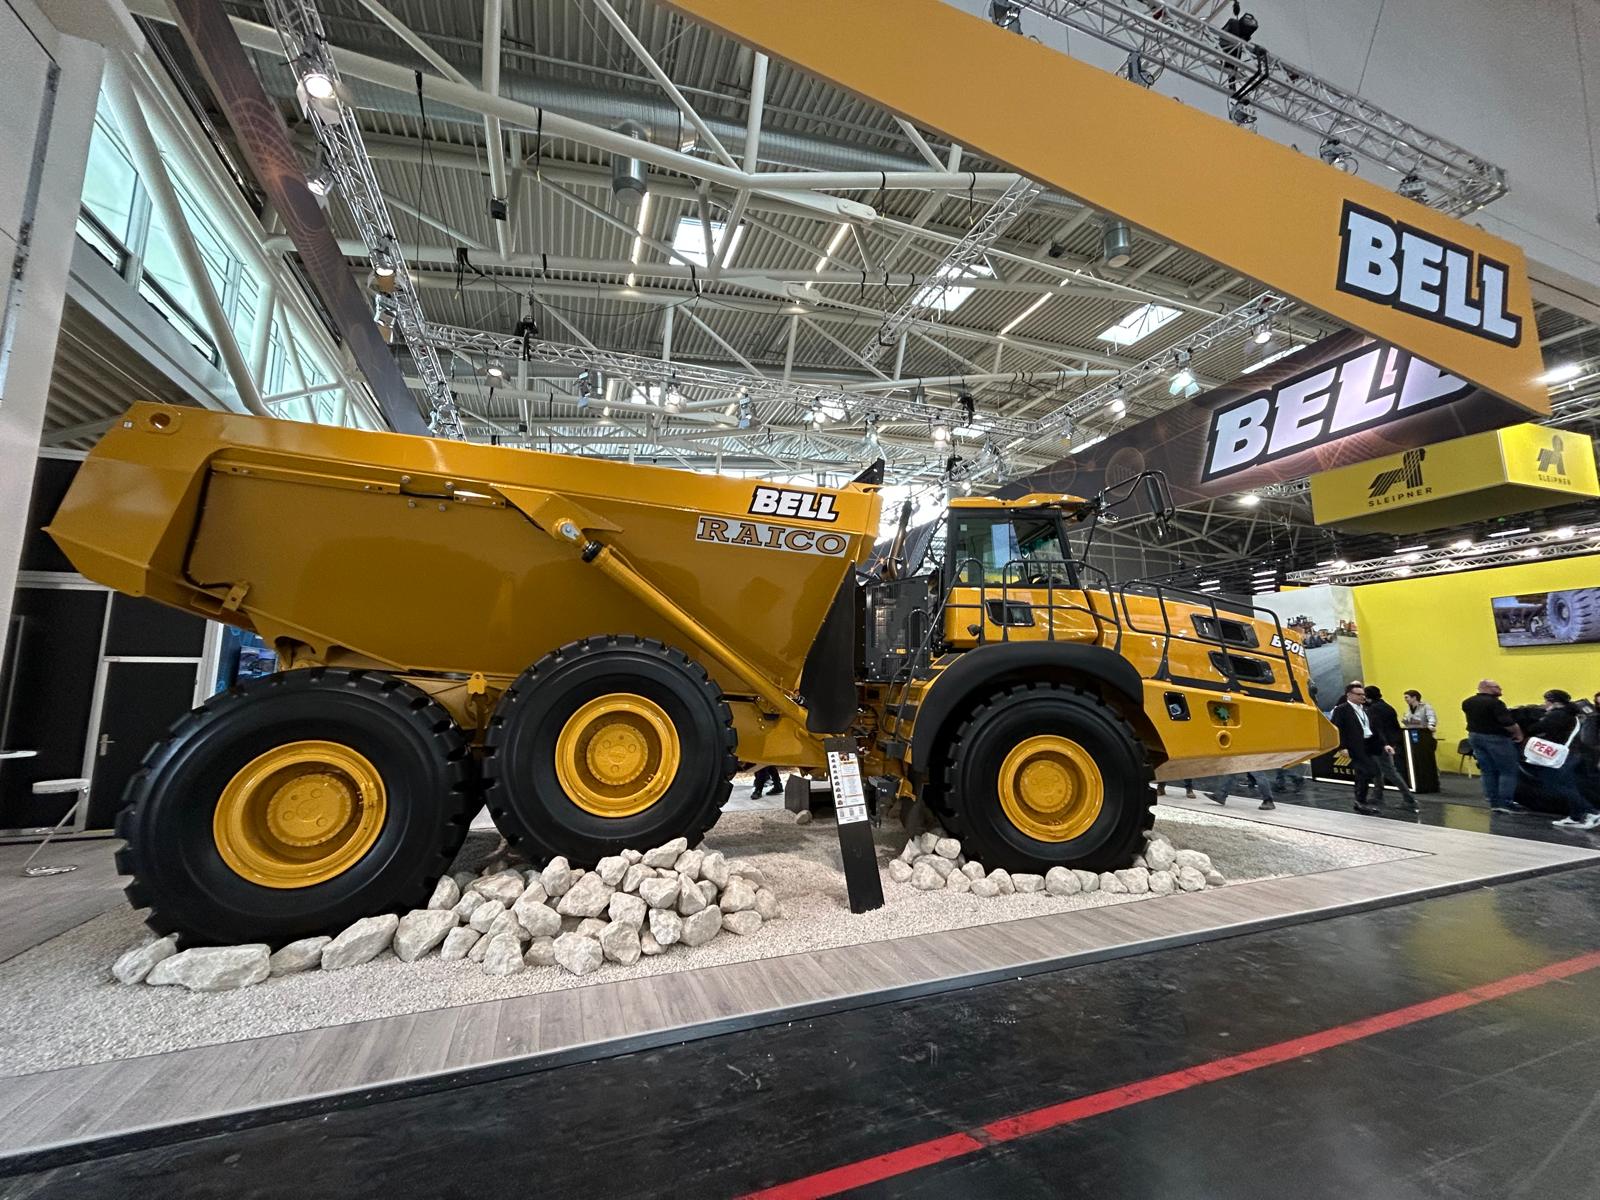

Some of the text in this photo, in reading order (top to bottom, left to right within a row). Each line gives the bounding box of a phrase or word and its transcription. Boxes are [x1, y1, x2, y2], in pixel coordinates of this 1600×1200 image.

[1340, 205, 1520, 343] BELL
[1538, 474, 1572, 485] SLEIPNER
[749, 487, 838, 521] BELL
[1368, 487, 1432, 507] SLEIPNER
[697, 518, 847, 554] RAICO
[1533, 741, 1559, 757] PERI
